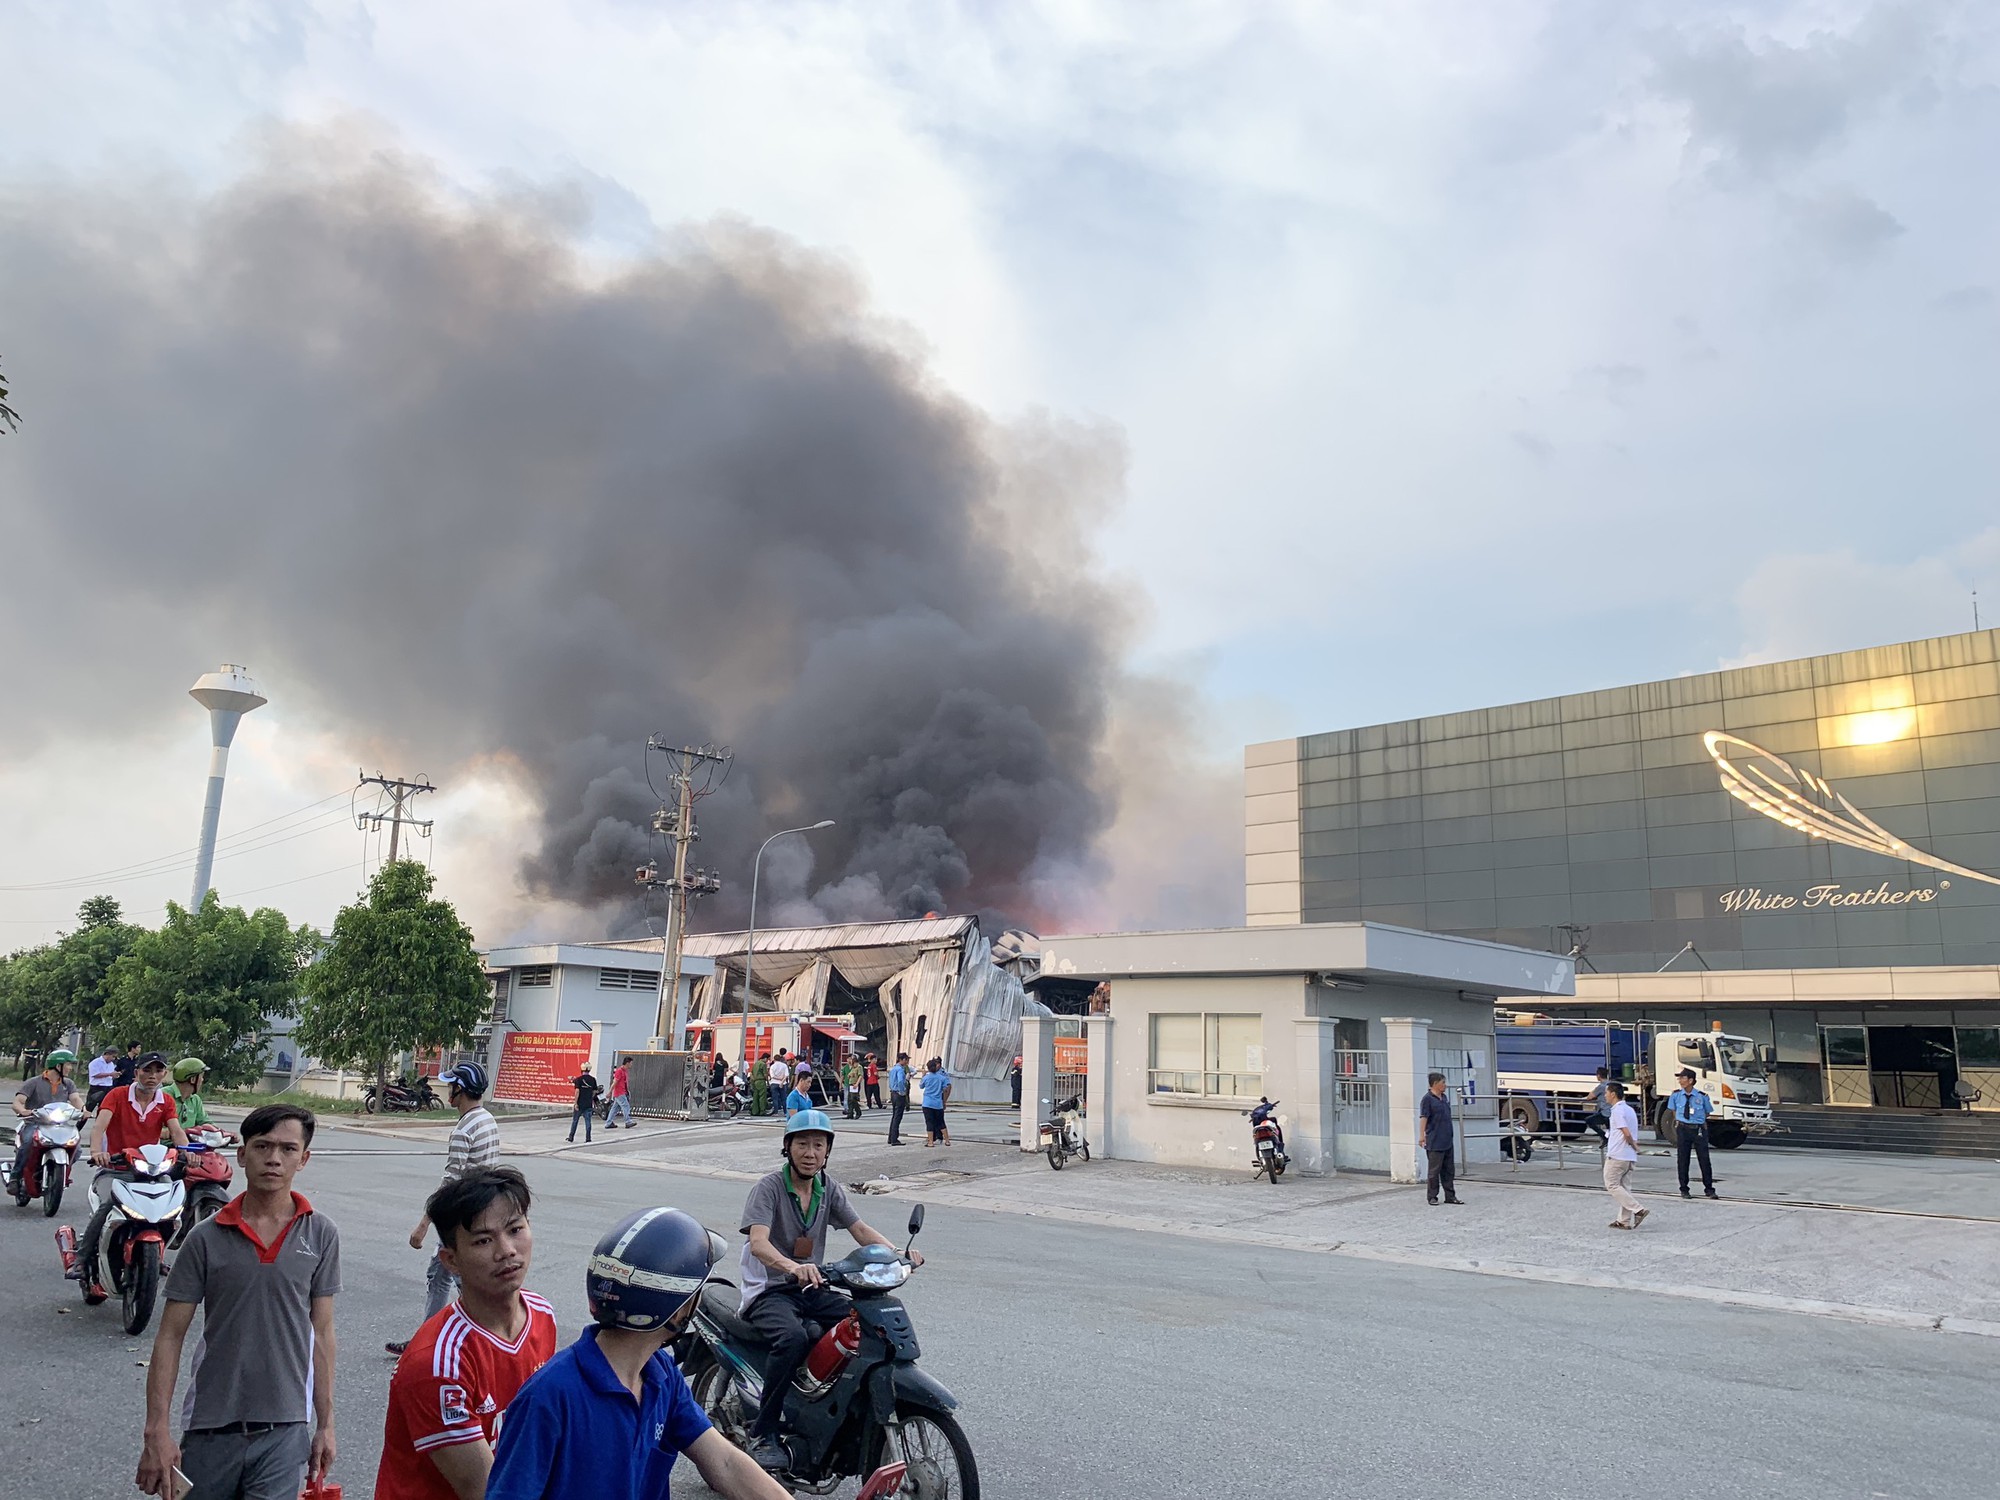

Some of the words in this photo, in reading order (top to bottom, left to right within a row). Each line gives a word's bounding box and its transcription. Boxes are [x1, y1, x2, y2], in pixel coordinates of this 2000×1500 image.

[1719, 887, 1799, 913] White
[1802, 881, 1939, 907] Feathers
[597, 1260, 630, 1276] mobifone
[446, 1410, 465, 1419] LIGA
